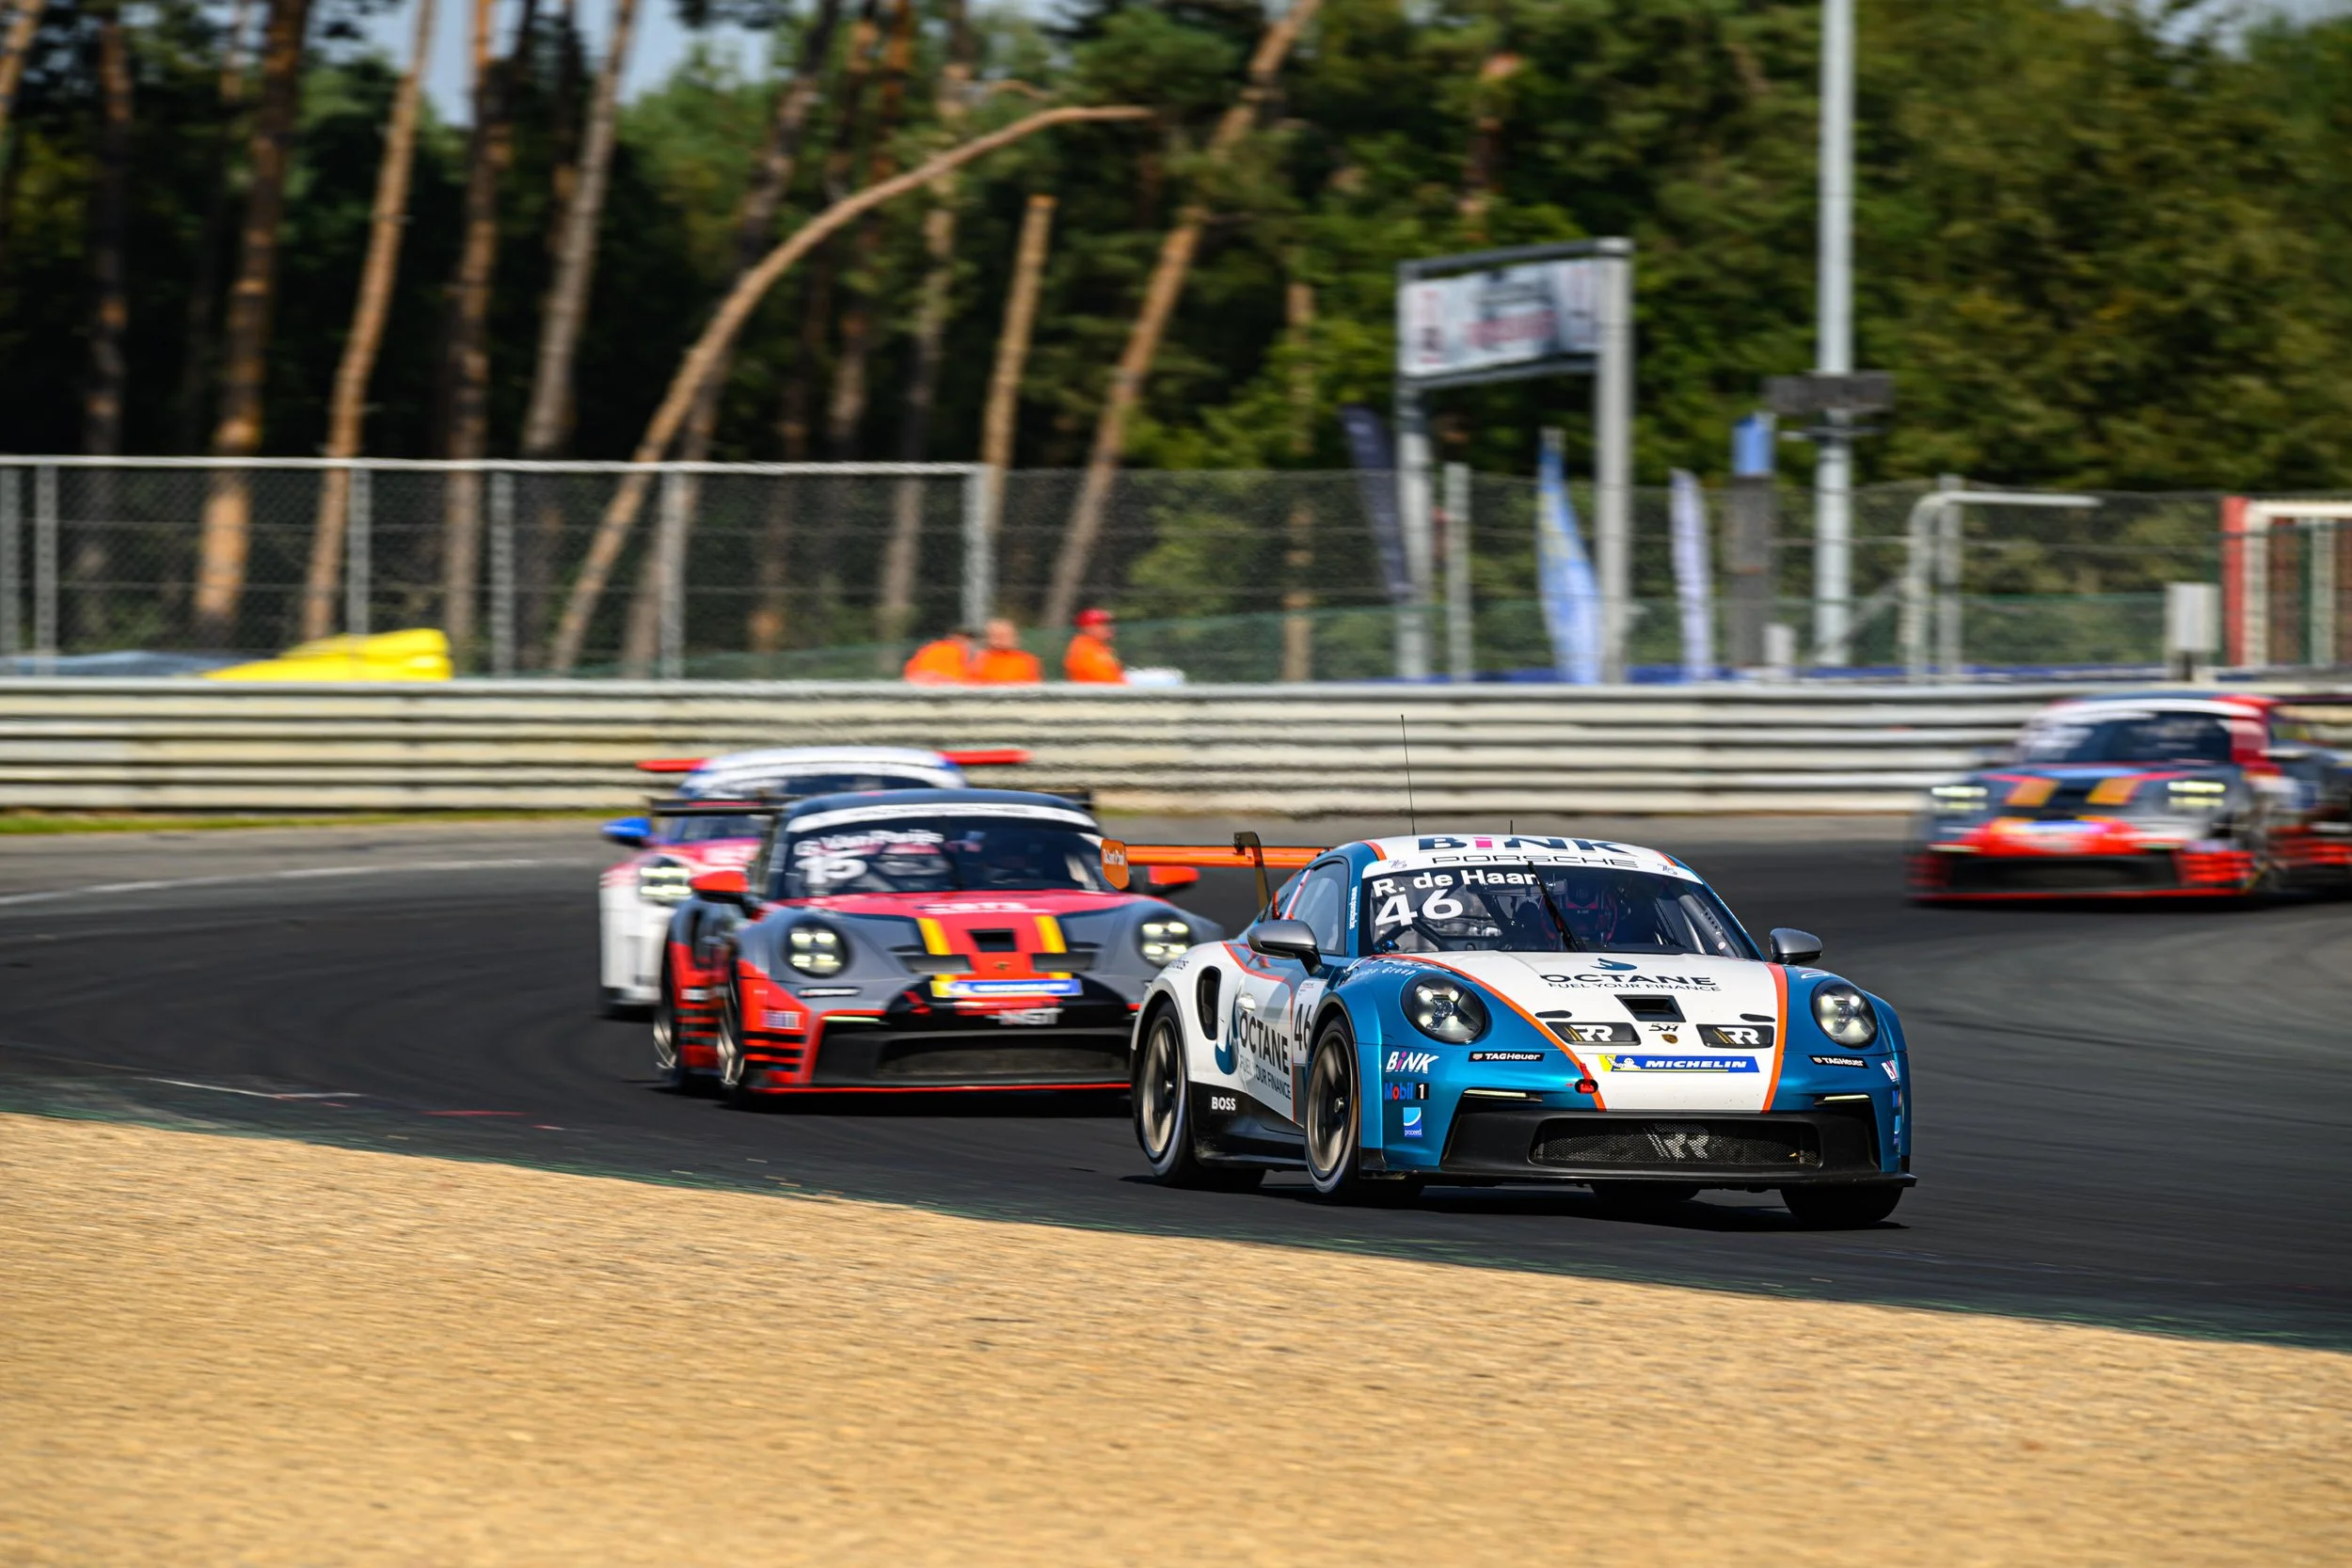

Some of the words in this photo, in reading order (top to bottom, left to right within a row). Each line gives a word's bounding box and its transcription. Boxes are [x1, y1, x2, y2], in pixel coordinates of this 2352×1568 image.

[1432, 855, 1639, 868] PORSCHE
[1373, 878, 1406, 897] R.
[1413, 872, 1453, 889] de
[1375, 889, 1463, 927] 46
[1540, 974, 1716, 986] OCTANE
[1295, 1004, 1311, 1051] 46
[1239, 1011, 1290, 1076] OCTANE
[1645, 1059, 1747, 1069] MICHELIN
[1385, 1084, 1414, 1100] Mobil
[1418, 1084, 1425, 1099] 1
[1211, 1097, 1236, 1111] BOSS
